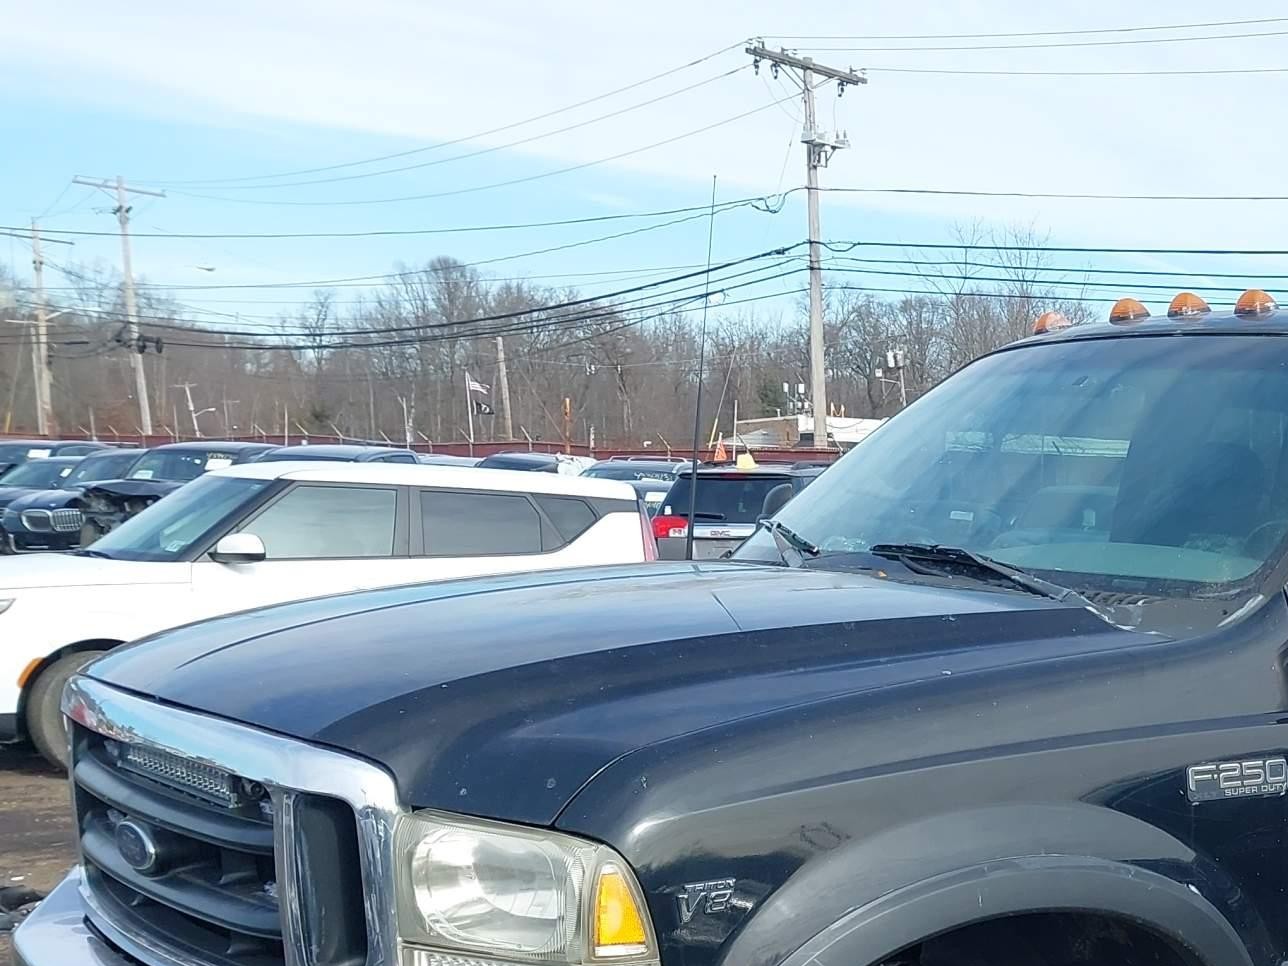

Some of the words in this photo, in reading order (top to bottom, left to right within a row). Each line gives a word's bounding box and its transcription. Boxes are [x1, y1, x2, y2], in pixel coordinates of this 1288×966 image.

[1224, 786, 1258, 796] SUPER
[1261, 782, 1287, 793] DUTY
[684, 878, 736, 892] TRITON
[676, 889, 734, 924] V8
